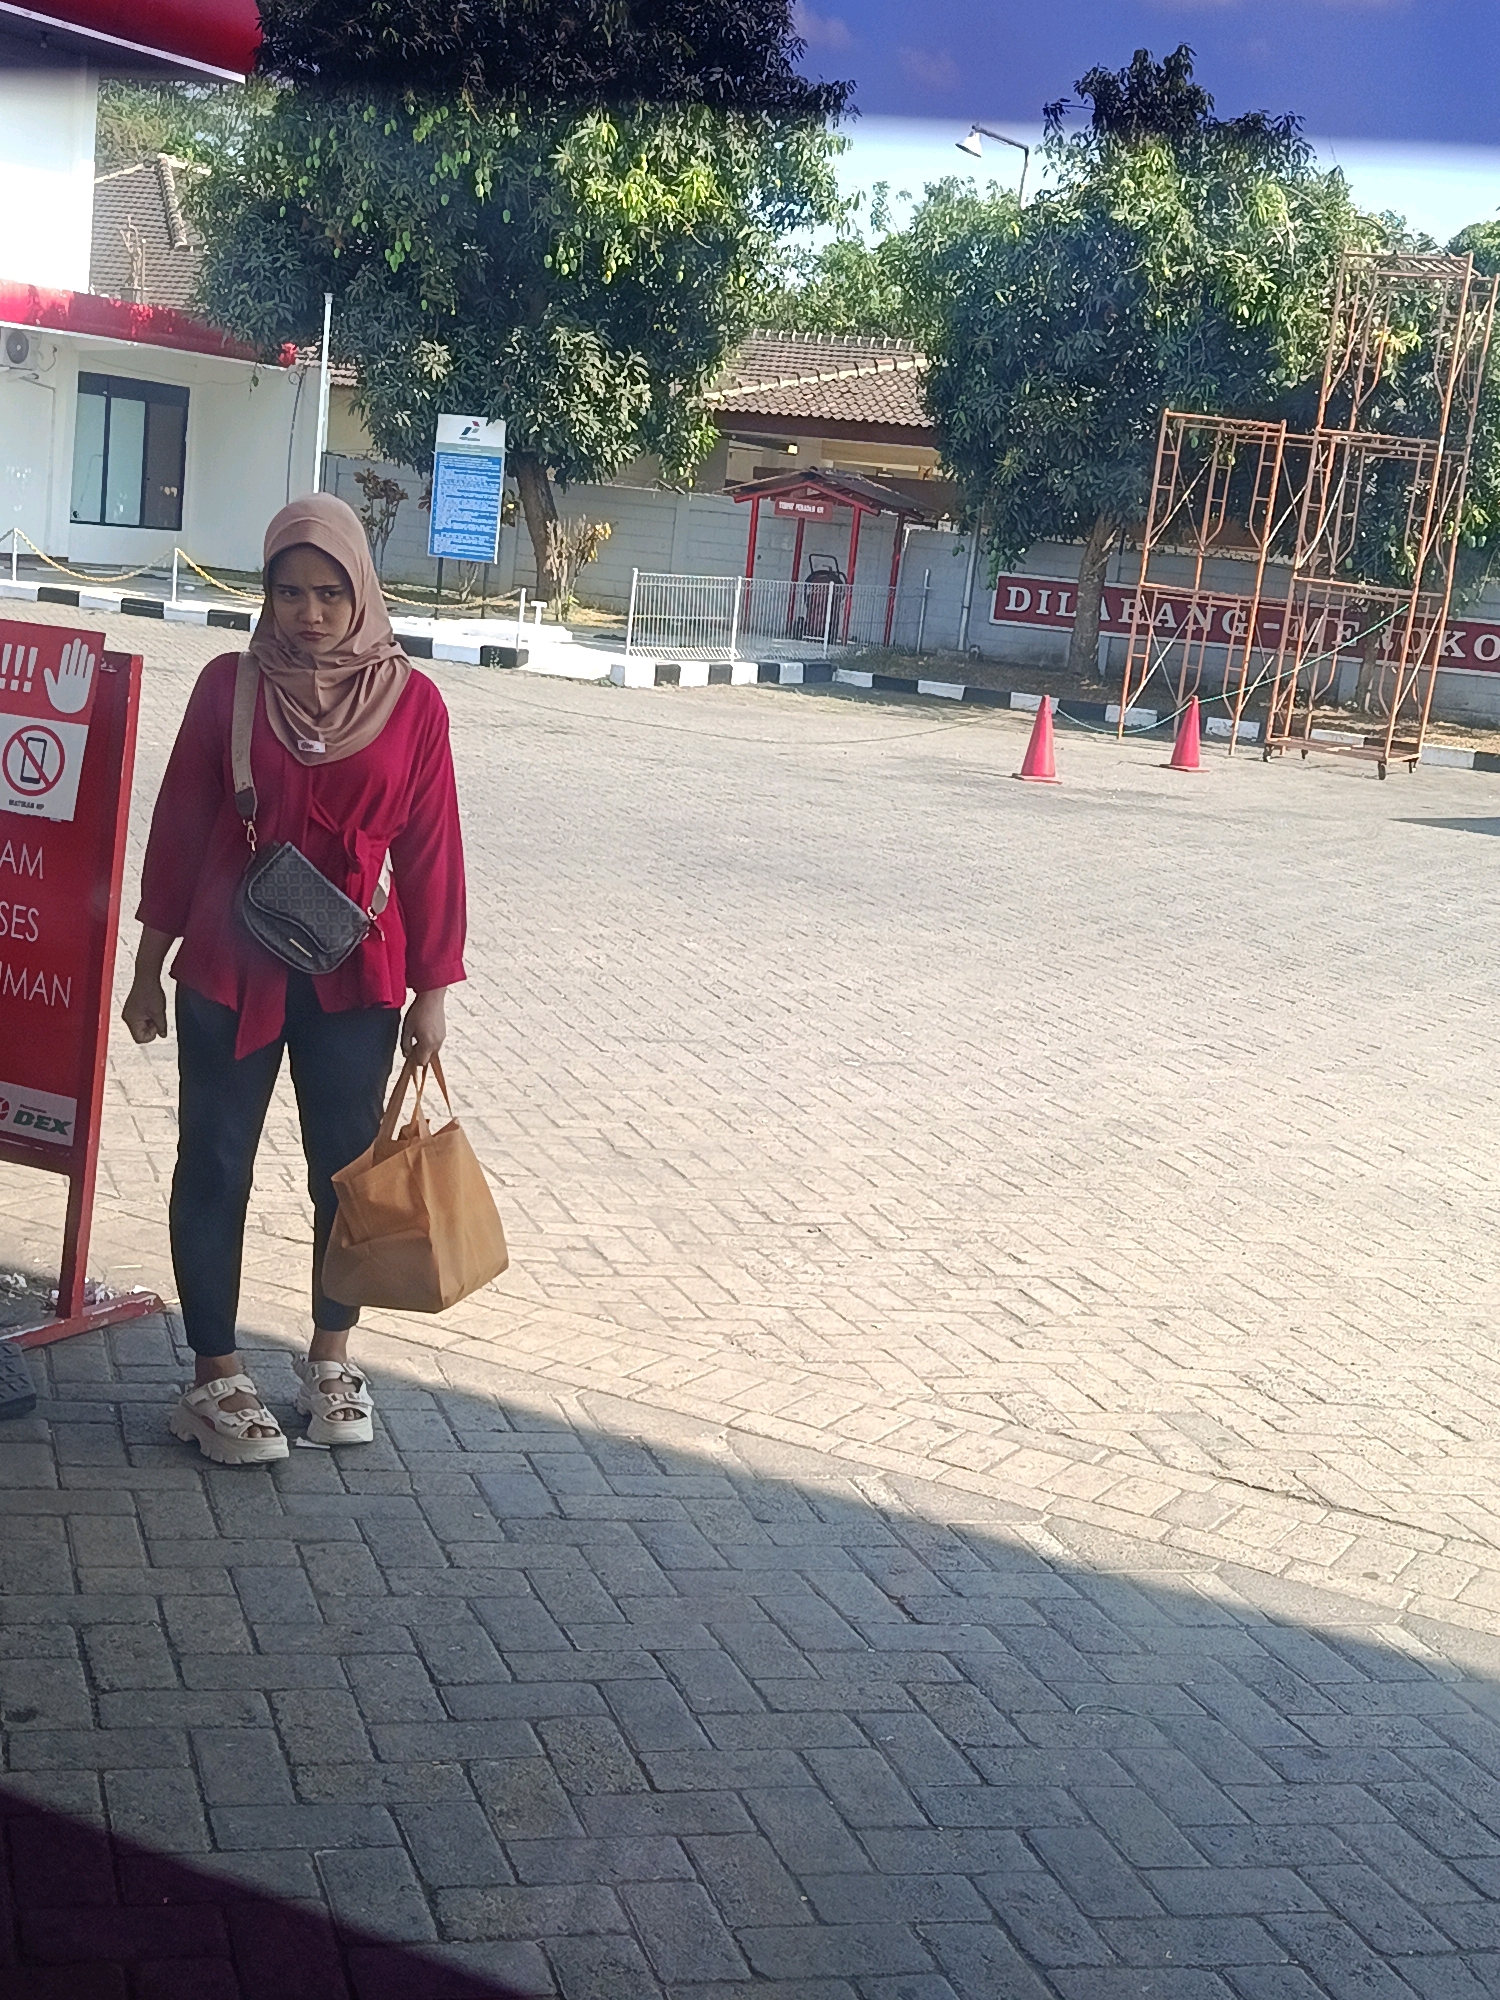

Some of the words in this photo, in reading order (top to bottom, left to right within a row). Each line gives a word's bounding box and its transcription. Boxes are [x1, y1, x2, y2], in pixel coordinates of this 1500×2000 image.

[0, 839, 44, 880] AM
[0, 900, 40, 942] SES
[13, 1109, 72, 1136] DEX
